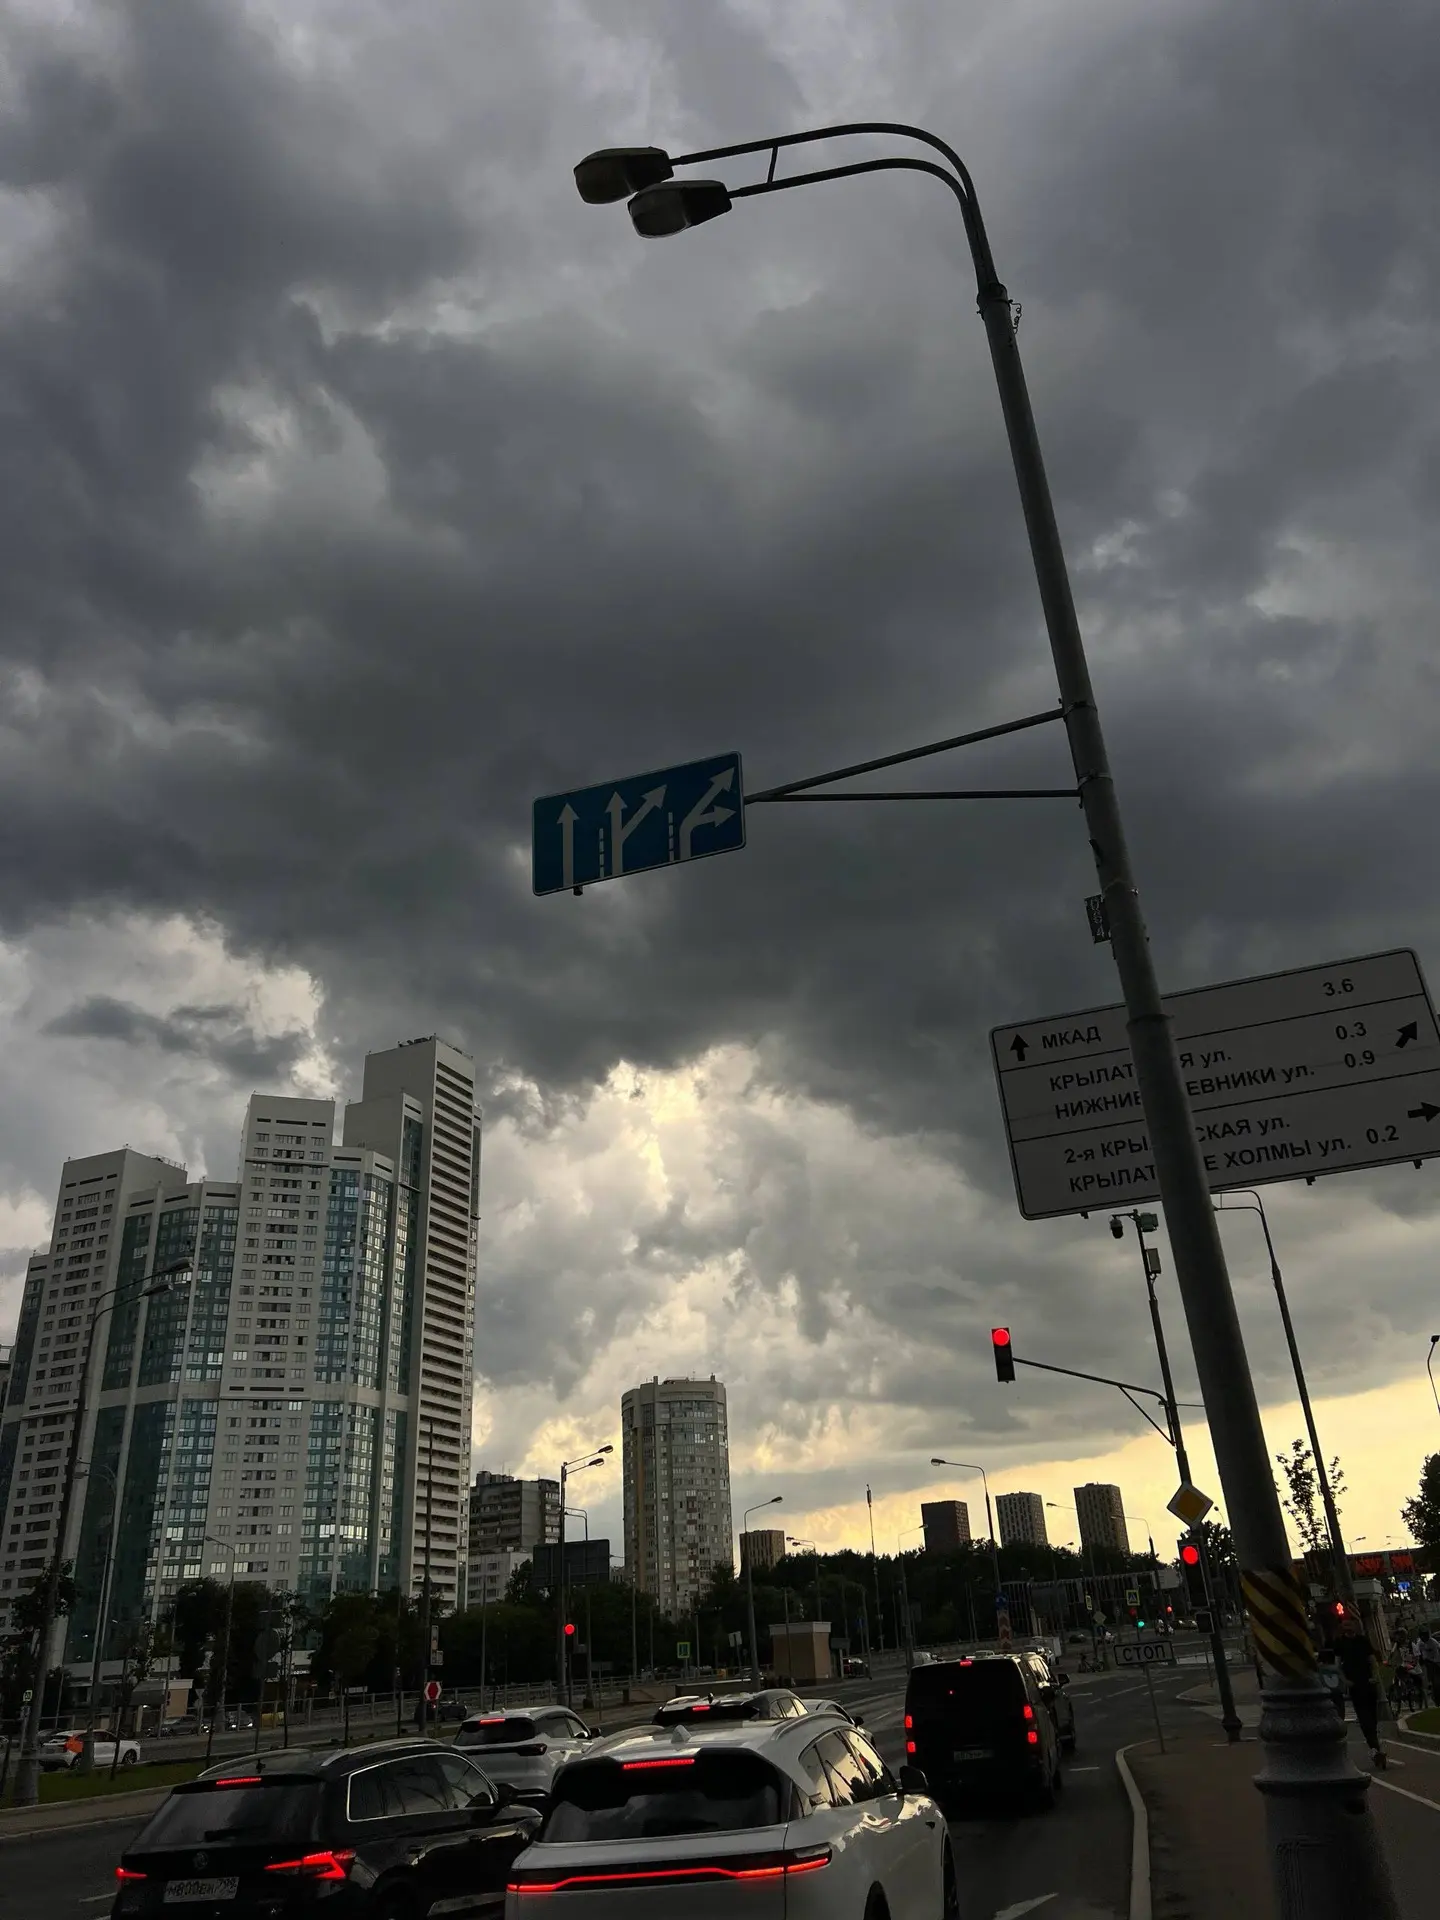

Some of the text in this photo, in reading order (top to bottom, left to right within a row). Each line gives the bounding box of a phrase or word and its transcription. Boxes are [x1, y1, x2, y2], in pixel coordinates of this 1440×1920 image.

[1041, 978, 1354, 1049] МКАД 3.6
[1050, 1022, 1367, 1092] КРЫЛАТЯ ул. 0.3
[1282, 1065, 1315, 1084] ул.
[1344, 1050, 1375, 1068] 0.9
[1064, 1148, 1096, 1164] 2-я
[1257, 1117, 1291, 1136] ул.
[1226, 1139, 1311, 1169] ХОЛМЫ
[1318, 1138, 1351, 1157] ул.
[1367, 1126, 1399, 1144] 0.2
[1123, 1645, 1166, 1662] СТОП
